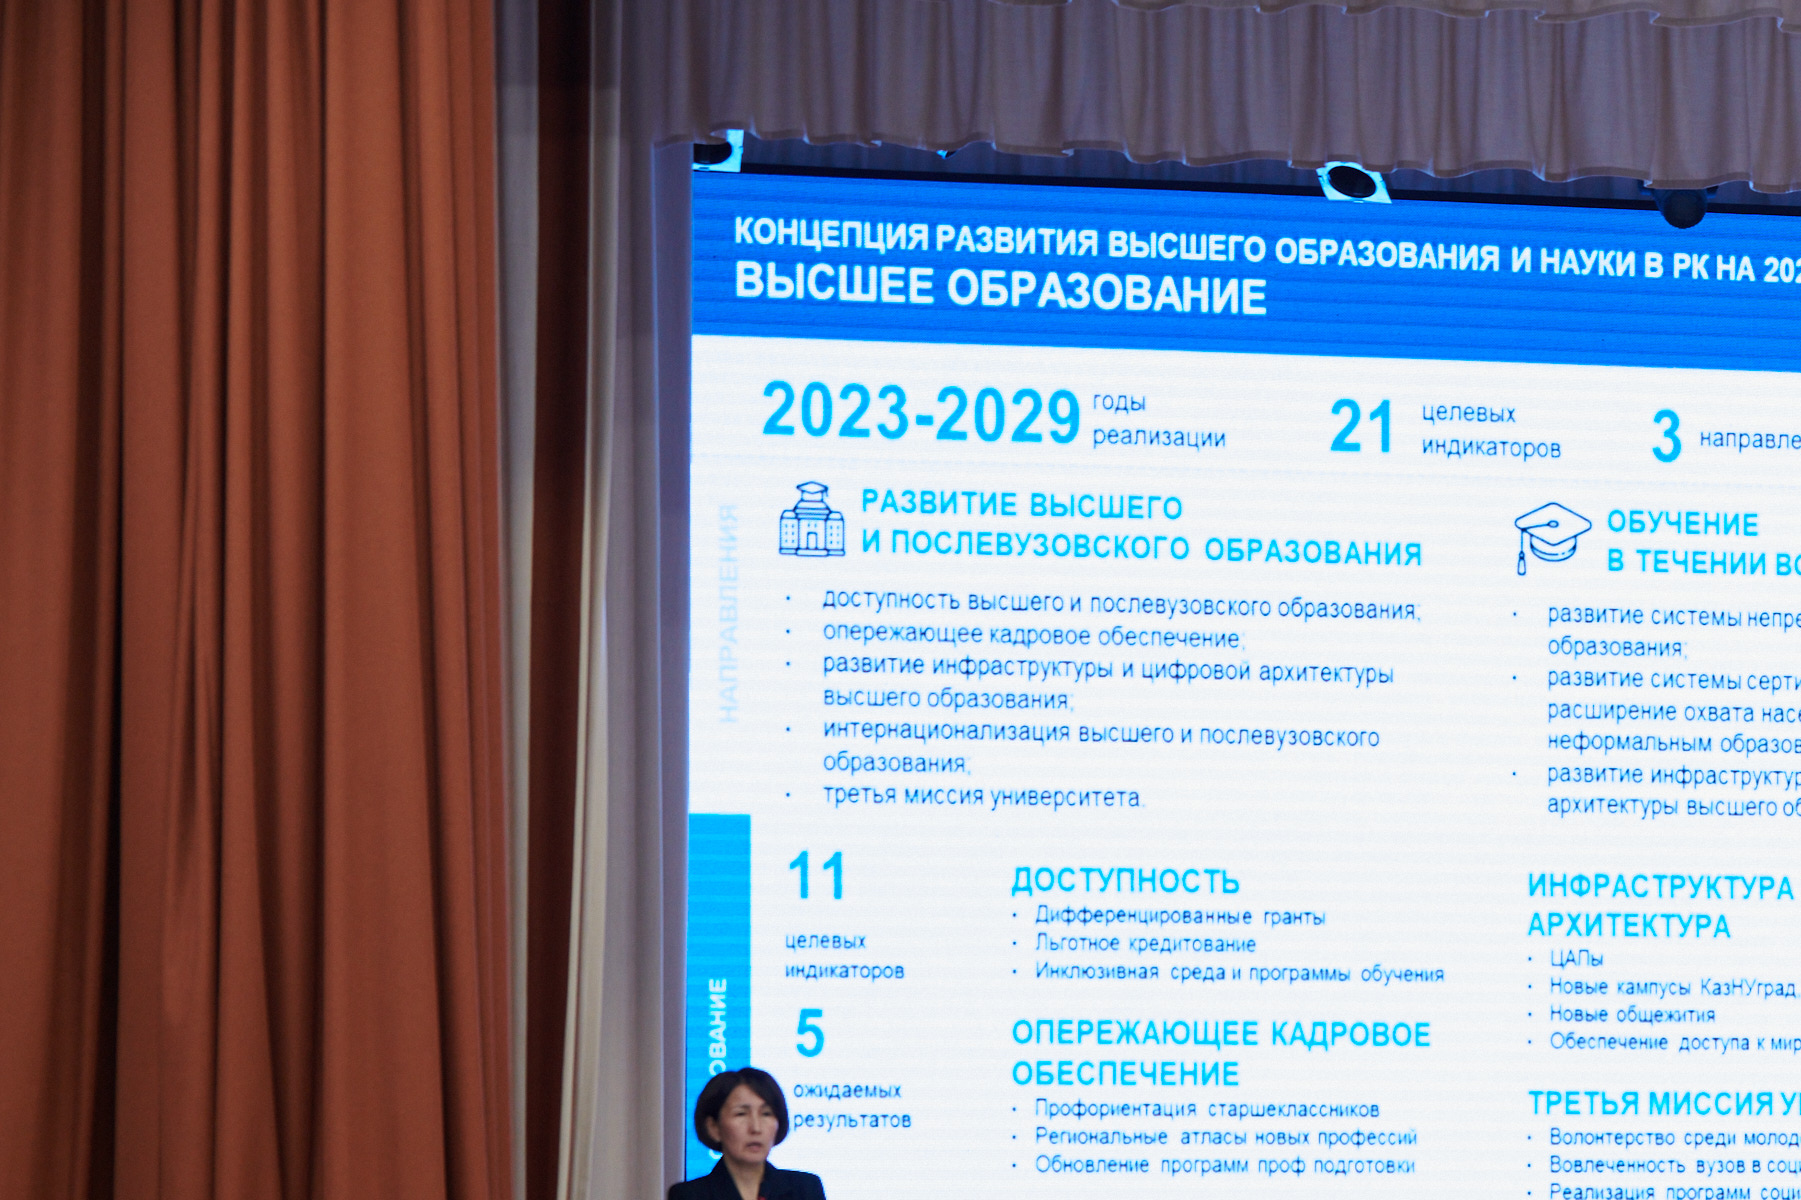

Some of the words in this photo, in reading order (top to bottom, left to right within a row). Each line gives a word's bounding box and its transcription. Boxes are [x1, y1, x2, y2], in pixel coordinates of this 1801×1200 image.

[736, 216, 928, 254] КОНЦЕПЦИЯ
[937, 224, 1098, 257] РАЗВИТИЯ
[1109, 230, 1266, 263] ВЫСШЕГО
[1276, 237, 1499, 271] ОБРАЗОВАНИЯ
[1512, 246, 1531, 273] И
[1541, 247, 1635, 277] НАУКИ
[1645, 251, 1663, 279] В
[1674, 252, 1709, 280] РК
[1717, 254, 1755, 282] НА
[737, 260, 933, 304] ВЫСШЕЕ
[948, 269, 1266, 315] ОБРАЗОВАНИЕ
[763, 379, 1080, 445] 2023-2029
[1093, 393, 1146, 415] годы
[1423, 404, 1516, 426] целевых
[1330, 398, 1390, 453] 21
[1652, 409, 1682, 463] 3
[1093, 428, 1226, 452] реализации
[1423, 438, 1561, 463] индикаторов
[862, 488, 1017, 516] РАЗВИТИЕ
[1030, 492, 1182, 520] ВЫСШЕГО
[1607, 509, 1758, 537] ОБУЧЕНИЕ
[862, 529, 880, 554] И
[892, 528, 1190, 560] ПОСЛЕВУЗОВСКОГО
[1205, 536, 1421, 566] ОБРАЗОВАНИЯ
[1608, 548, 1624, 573] В
[1636, 548, 1766, 576] ТЕЧЕНИИ
[718, 503, 739, 723] НАПРАВЛЕНИЯ
[1548, 605, 1644, 627] развитие
[1651, 608, 1742, 628] системы
[823, 656, 925, 678] развитие
[933, 655, 1113, 683] инфраструктуры
[1123, 662, 1134, 678] и
[1142, 658, 1250, 685] цифровой
[1259, 665, 1393, 689] архитектуры
[1548, 703, 1677, 724] расширение
[1684, 704, 1754, 724] охвата
[824, 721, 1070, 747] интернационализация
[1079, 724, 1174, 744] высшего
[1181, 727, 1192, 743] и
[1200, 727, 1380, 751] послевузовского
[789, 850, 843, 900] 11
[1011, 866, 1240, 898] ДОСТУПНОСТЬ
[1529, 872, 1794, 901] ИНФРАСТРУКТУРА
[1035, 904, 1252, 927] Дифференцированные
[1264, 910, 1326, 928] гранты
[1528, 911, 1731, 939] АРХИТЕКТУРА
[786, 934, 866, 951] целевых
[1036, 932, 1120, 952] Льготное
[1129, 936, 1256, 956] кредитование
[785, 964, 905, 982] индикаторов
[1551, 948, 1603, 970] ЦАПы
[1550, 1005, 1609, 1023] Новые
[1617, 1004, 1715, 1025] общежития
[796, 1008, 825, 1058] 5
[1012, 1019, 1258, 1051] ОПЕРЕЖАЮЩЕЕ
[1272, 1020, 1430, 1052] КАДРОВОЕ
[1550, 1031, 1668, 1051] Обеспечение
[1679, 1036, 1750, 1056] доступа
[1757, 1038, 1765, 1050] к
[1012, 1060, 1239, 1087] ОБЕСПЕЧЕНИЕ
[793, 1084, 901, 1100] ожидаемых
[1528, 1089, 1639, 1116] ТРЕТЬЯ
[1649, 1090, 1773, 1117] МИССИЯ
[792, 1112, 913, 1132] результатов
[1035, 1097, 1196, 1121] Профориентация
[1208, 1102, 1380, 1120] старшеклассников
[1036, 1125, 1168, 1145] Региональные
[1181, 1130, 1247, 1146] атласы
[1255, 1131, 1309, 1146] новых
[1318, 1128, 1417, 1150] профессий
